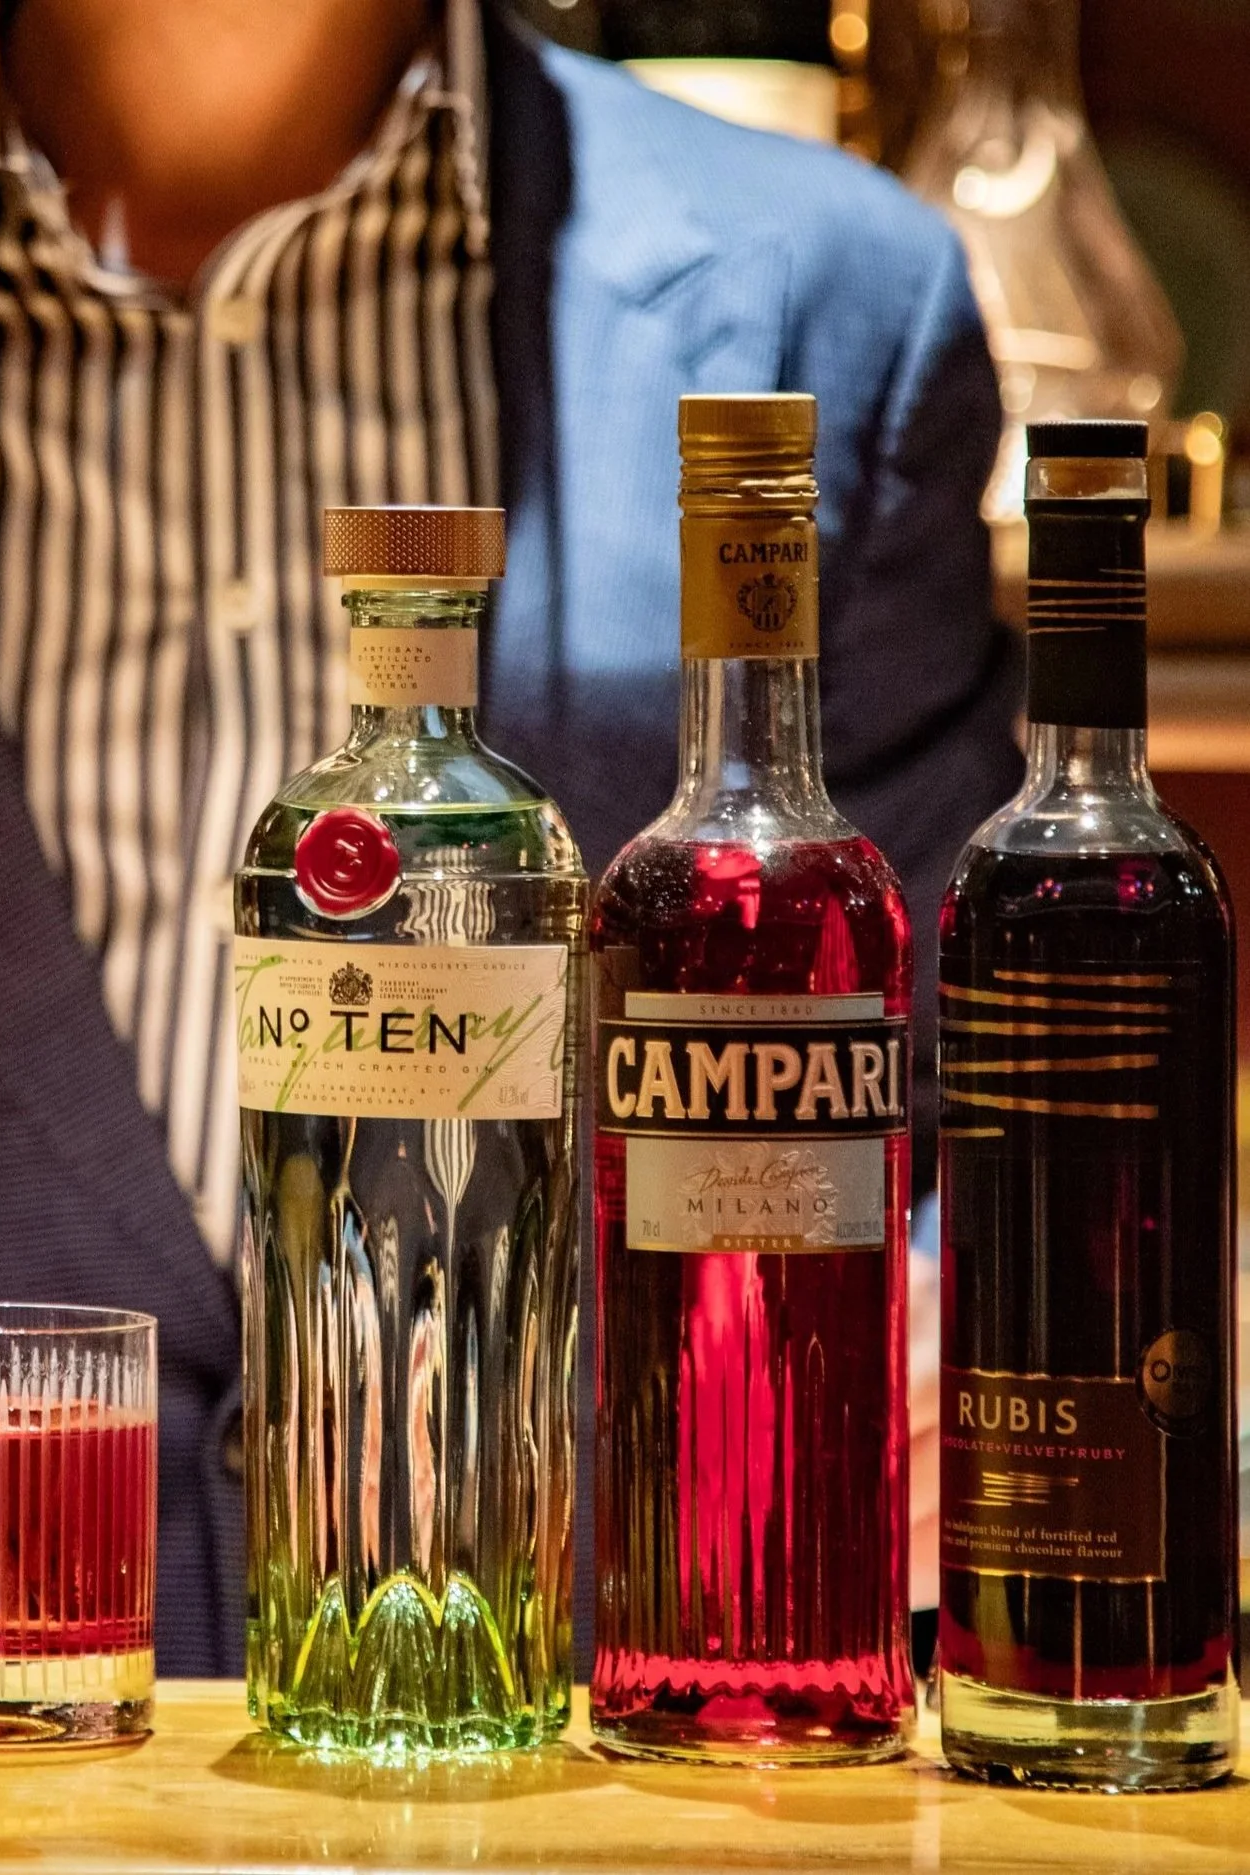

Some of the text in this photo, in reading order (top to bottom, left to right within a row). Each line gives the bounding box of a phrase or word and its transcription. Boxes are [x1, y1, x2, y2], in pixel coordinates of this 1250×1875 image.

[719, 543, 808, 564] CAMPARI
[700, 1004, 757, 1015] SINCE
[330, 1010, 467, 1055] TEN
[359, 1063, 446, 1074] CRAFTED
[608, 1036, 901, 1120] CAMPARI
[688, 1198, 828, 1213] MILANO
[723, 1238, 792, 1248] BITTER
[959, 1392, 1078, 1435] RUBIS
[991, 1524, 1020, 1538] blend
[1024, 1528, 1036, 1539] of
[1040, 1528, 1092, 1543] fortified
[1097, 1532, 1117, 1543] red
[969, 1538, 1011, 1553] premium
[1015, 1543, 1073, 1557] chocolate
[1077, 1545, 1123, 1559] flavour
